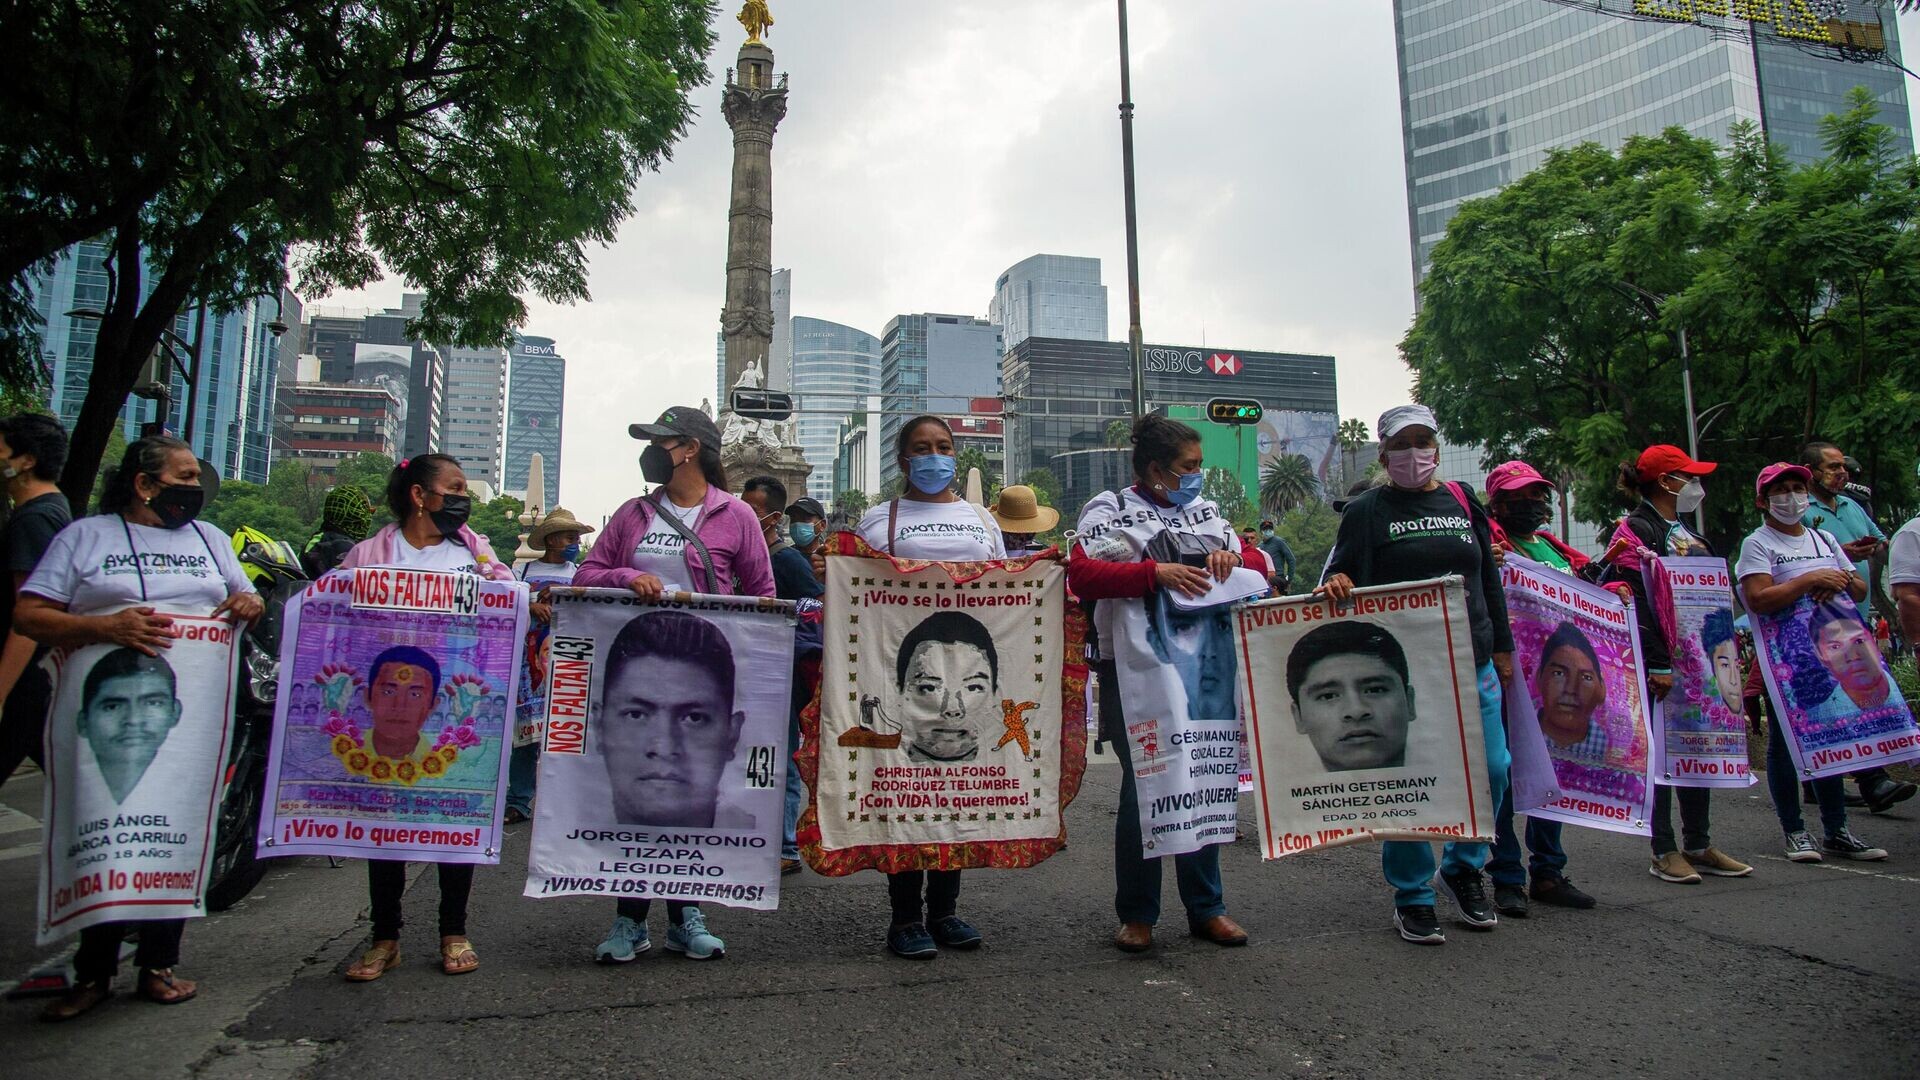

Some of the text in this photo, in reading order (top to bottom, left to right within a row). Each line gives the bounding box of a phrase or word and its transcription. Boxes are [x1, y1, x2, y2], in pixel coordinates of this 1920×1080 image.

[525, 345, 553, 354] BBVA
[1127, 348, 1203, 374] SBC
[1136, 511, 1157, 523] SE
[1162, 516, 1182, 528] OS
[1461, 534, 1473, 544] 43
[1699, 574, 1716, 586] se
[1718, 571, 1728, 587] lo
[353, 569, 479, 614] NOS FALTAN 43!
[864, 590, 1032, 608] ¡Vivo se lo llevaron!
[1502, 567, 1539, 591] ¡Vivo
[1542, 584, 1556, 599] se
[1559, 587, 1571, 604] lo
[1573, 592, 1626, 625] llevaron!
[1246, 606, 1297, 631] ¡Vivo
[1303, 605, 1323, 621] se
[1353, 589, 1439, 616] llevaron!
[175, 622, 231, 646] varon!
[548, 635, 595, 754] NOS FALTAN 43!
[1204, 730, 1240, 742] MANUE
[1680, 736, 1710, 746] JORGE
[1812, 748, 1853, 769] ¡Vivo
[1855, 743, 1873, 757] lo
[746, 746, 775, 788] 43!
[874, 766, 1006, 778] CHRISTIAN ALFONSO
[1675, 758, 1719, 777] ¡Vivo
[1723, 760, 1734, 775] lo
[871, 779, 1020, 791] RODRÍGUEZ TELUMBRE
[1291, 776, 1437, 798] MARTÍN GETSEMANY
[415, 796, 467, 808] Baranda
[859, 792, 1029, 812] ¡Con VIDA lo queremos!
[1151, 792, 1196, 819] ¡VIVOS
[1302, 790, 1430, 811] SÁNCHEZ GARCÍA
[1323, 808, 1417, 822] EDAD 20 AÑOS
[78, 814, 171, 836] LUIS ÁNGEL
[284, 818, 481, 847] ¡Vivo lo queremos!
[1152, 822, 1181, 835] CONTRA
[1183, 821, 1191, 830] EL
[116, 831, 187, 845] CARRILLO
[566, 829, 766, 848] JORGE ANTONIO
[1278, 830, 1312, 854] ¡Con
[114, 850, 133, 859] 18
[138, 848, 173, 858] AÑOS
[621, 847, 704, 861] TIZAPA
[599, 861, 724, 877] LEGIDEÑO
[73, 872, 103, 901] VIDA
[108, 869, 128, 890] lo
[132, 869, 196, 893] queremos!
[541, 877, 764, 902] ¡VIVOS LOS QUEREMOS!
